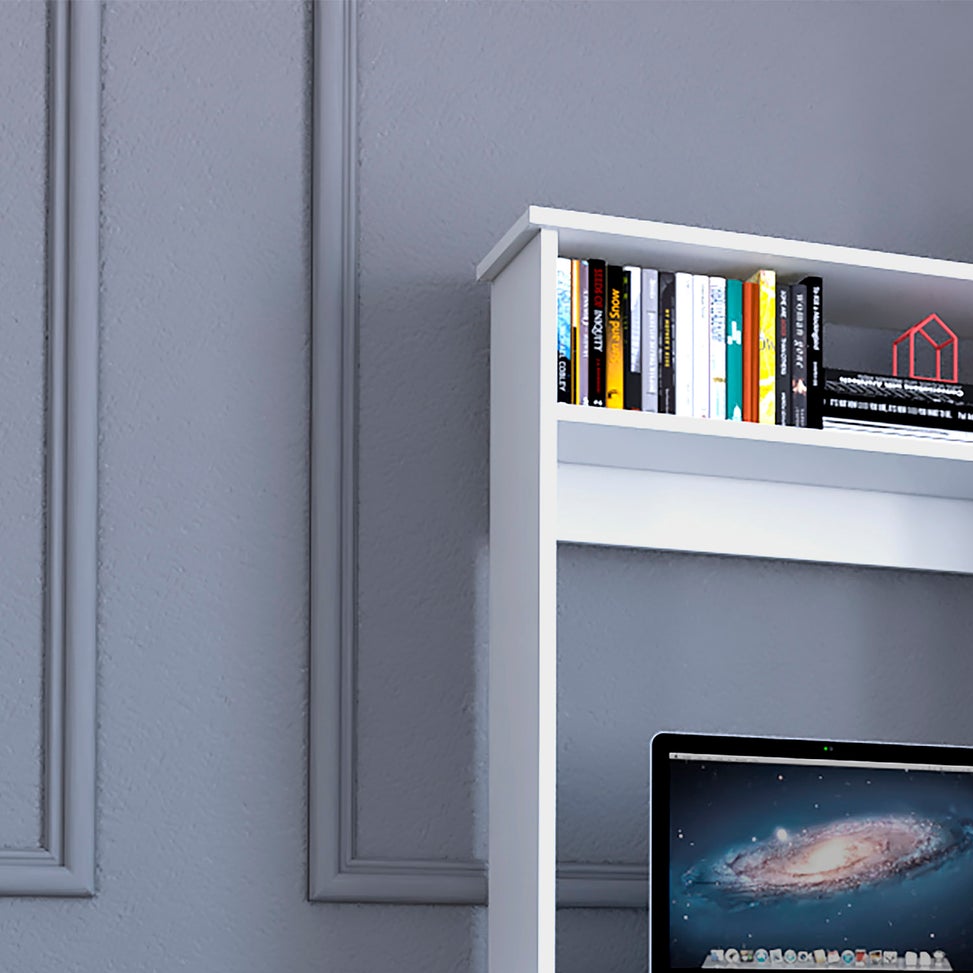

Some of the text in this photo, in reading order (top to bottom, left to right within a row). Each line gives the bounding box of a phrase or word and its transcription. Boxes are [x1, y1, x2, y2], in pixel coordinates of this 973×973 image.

[609, 288, 620, 319] Snow
[796, 293, 804, 336] woman
[591, 309, 603, 352] INIQUITY
[609, 320, 620, 341] and
